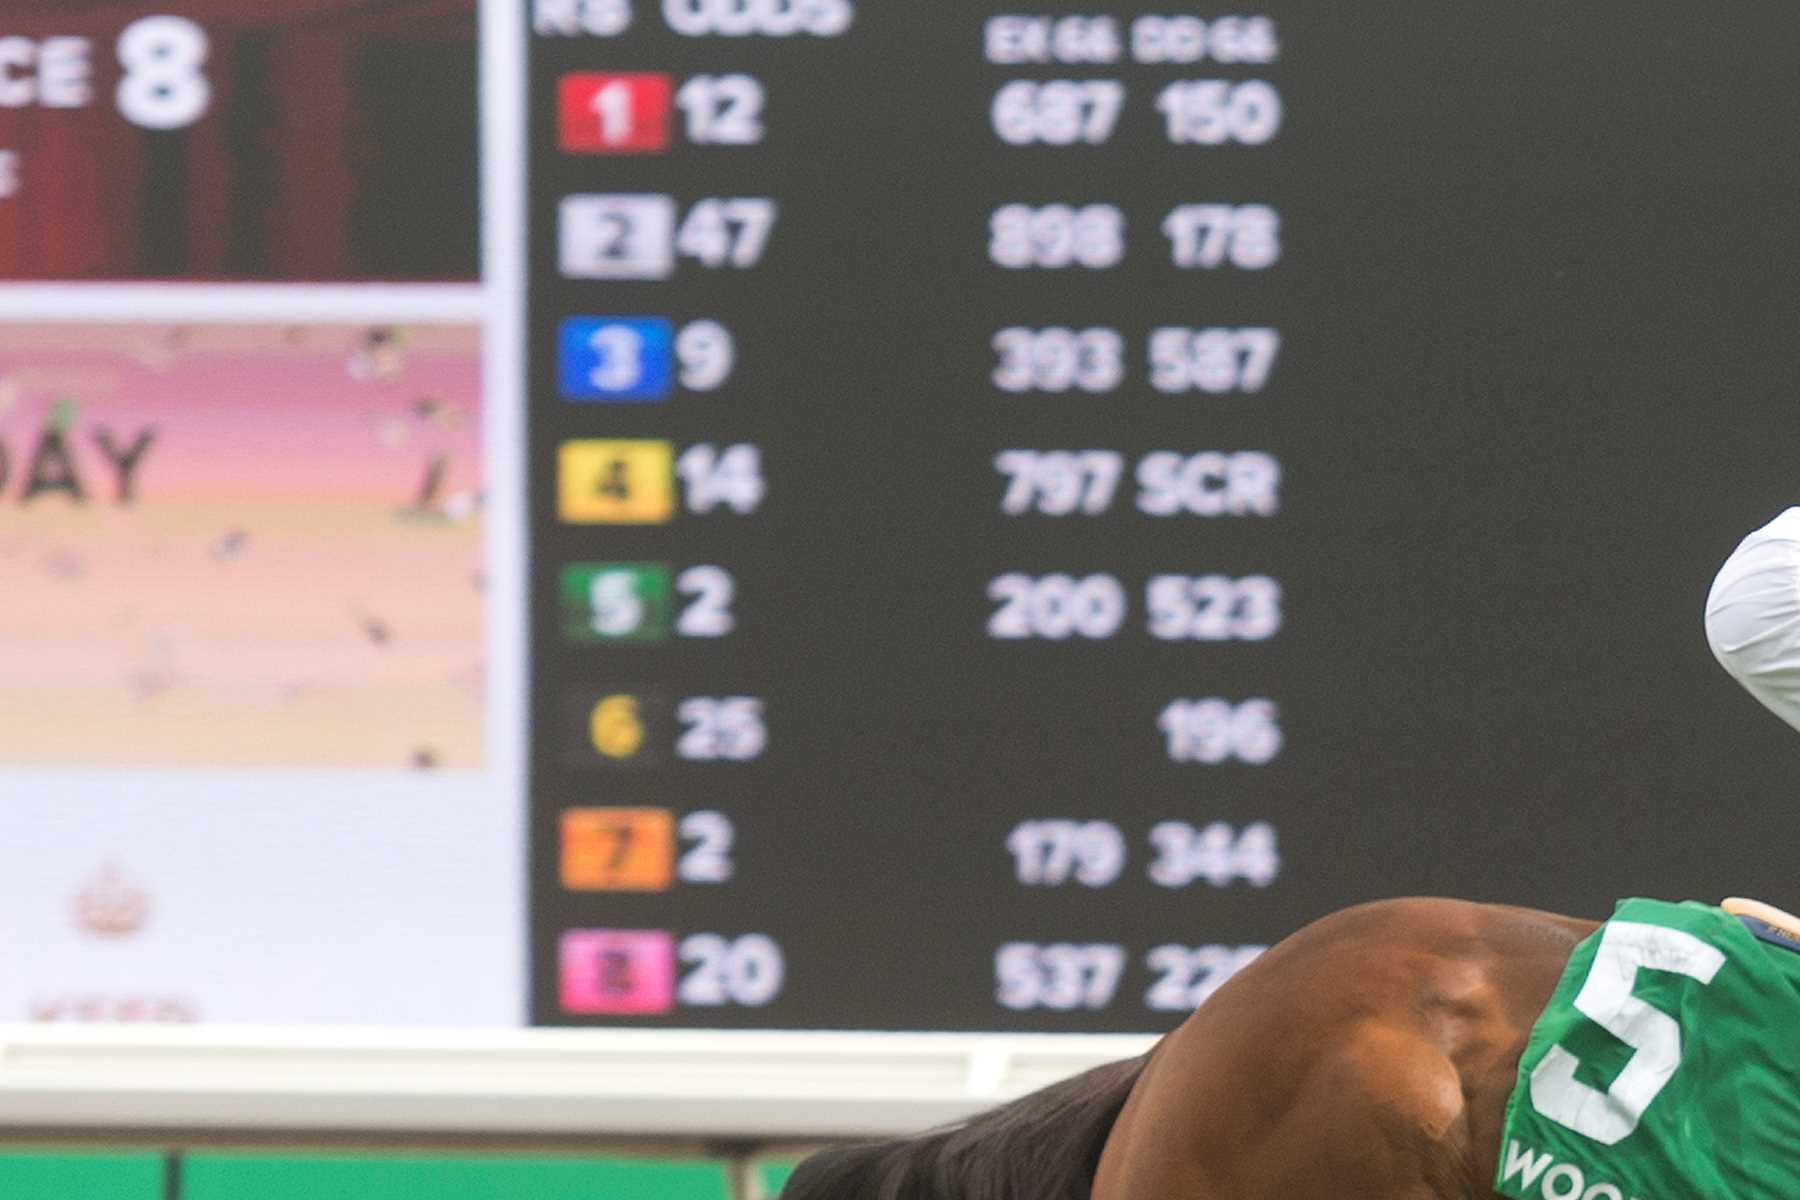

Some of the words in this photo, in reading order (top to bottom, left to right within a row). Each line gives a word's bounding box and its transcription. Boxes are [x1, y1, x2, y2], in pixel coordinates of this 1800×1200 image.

[116, 15, 210, 129] 8
[592, 81, 632, 144] 1
[676, 74, 764, 144] 12
[992, 81, 1124, 145] 687
[1157, 80, 1281, 145] 150
[598, 212, 633, 260] 2
[675, 198, 775, 266] 47
[1164, 205, 1279, 268] 178
[590, 325, 641, 391] 3
[676, 321, 733, 390] 9
[995, 327, 1123, 392] 393
[1149, 327, 1279, 392] 587
[0, 424, 160, 502] AY
[597, 460, 629, 500] 4
[676, 445, 764, 511] 14
[995, 450, 1123, 515] 797
[1137, 451, 1279, 515] SCR
[590, 570, 642, 636] 5
[677, 565, 733, 636] 2
[988, 574, 1125, 640] 200
[1147, 575, 1281, 640] 523
[590, 695, 642, 757] 6
[677, 697, 766, 760] 25
[1160, 699, 1281, 764] 196
[602, 826, 633, 872] 7
[677, 811, 733, 882] 2
[1008, 821, 1125, 886] 179
[1149, 822, 1279, 886] 344
[677, 933, 784, 1006] 20
[995, 942, 1124, 1010] 537
[1530, 921, 1726, 1145] 5
